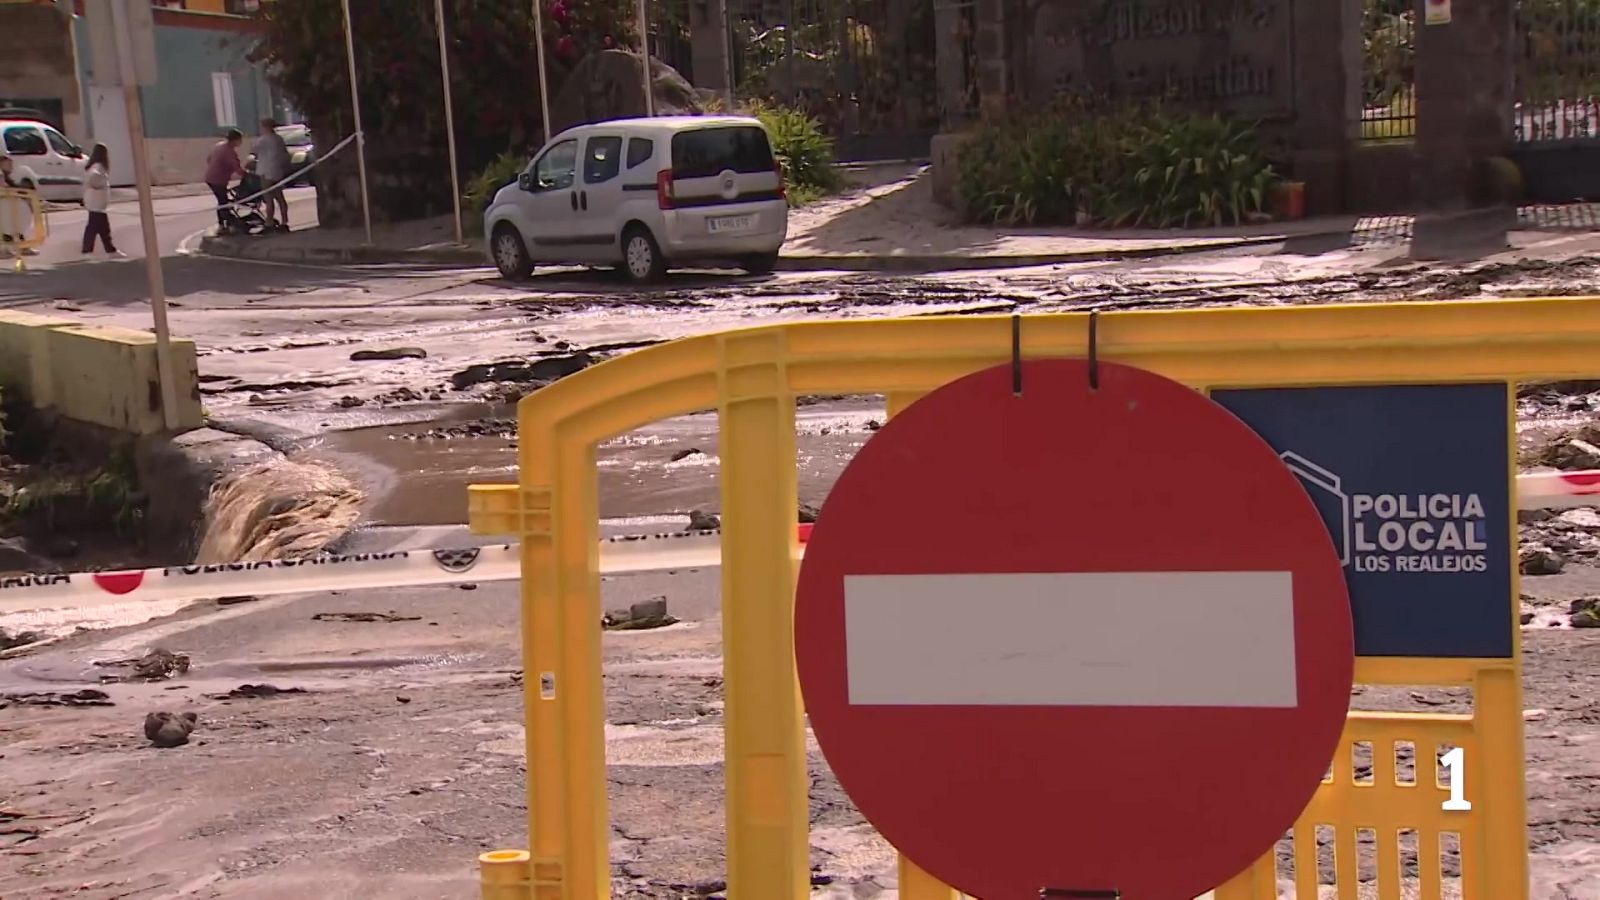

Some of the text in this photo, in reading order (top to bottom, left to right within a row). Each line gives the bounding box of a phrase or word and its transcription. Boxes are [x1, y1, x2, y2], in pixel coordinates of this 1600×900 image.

[1353, 493, 1485, 519] POLICIA
[1354, 521, 1487, 552] LOCAL
[1354, 555, 1487, 573] LOS REALEJOS
